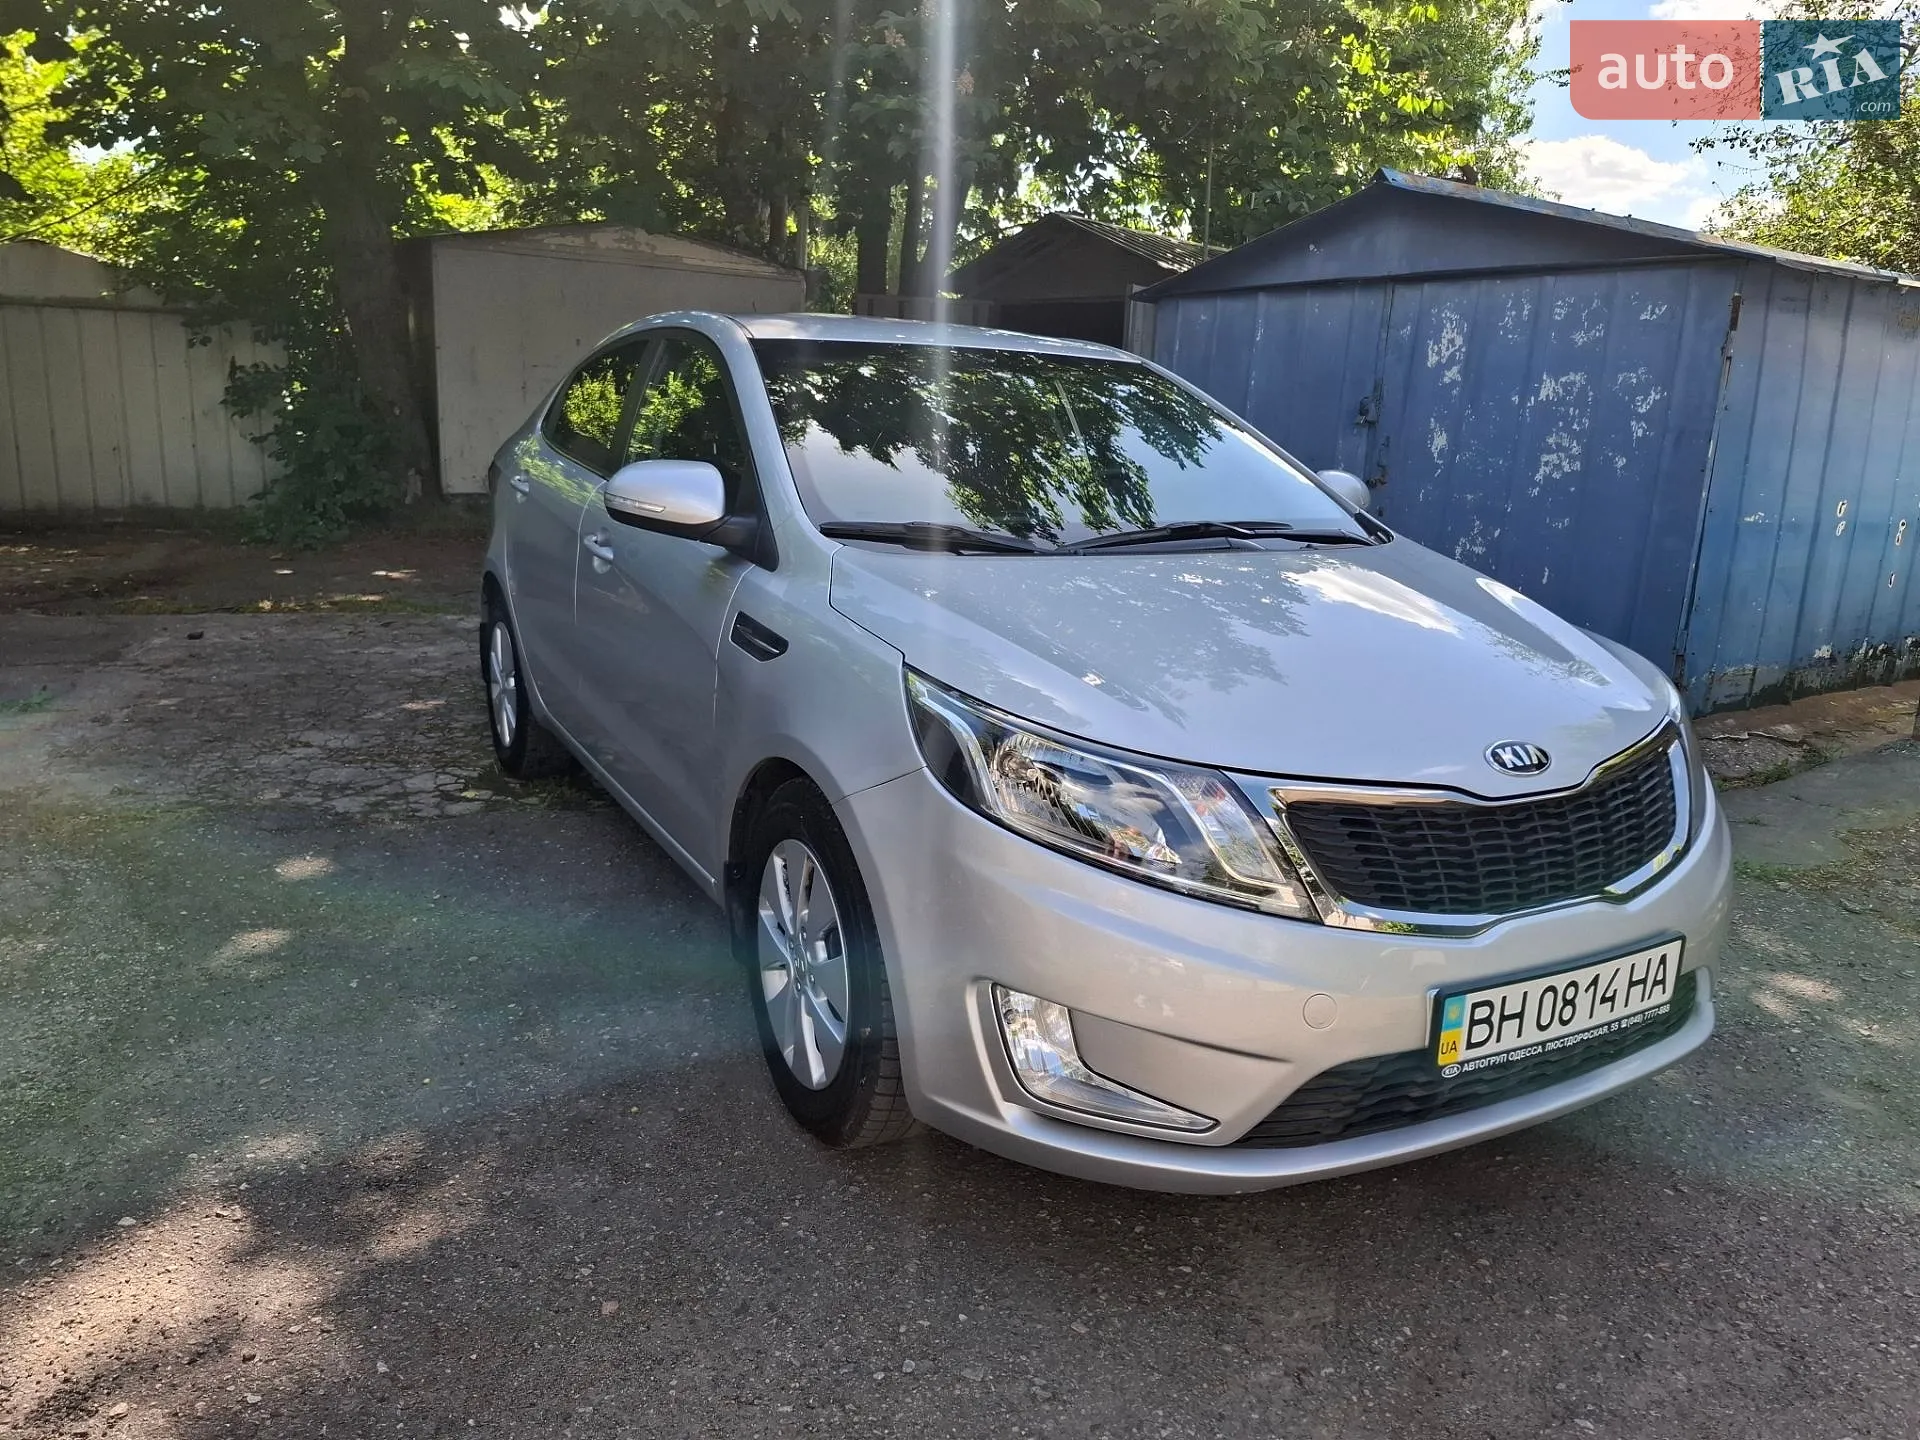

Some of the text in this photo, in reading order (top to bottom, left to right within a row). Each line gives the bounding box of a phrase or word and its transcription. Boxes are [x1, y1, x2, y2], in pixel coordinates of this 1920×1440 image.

[1495, 744, 1548, 769] KIA
[1465, 952, 1668, 1051] BH 0814 HA
[1441, 1040, 1458, 1055] UA
[1462, 1053, 1508, 1072] АВТОГРУП
[1508, 1045, 1543, 1061] ОДЕССА
